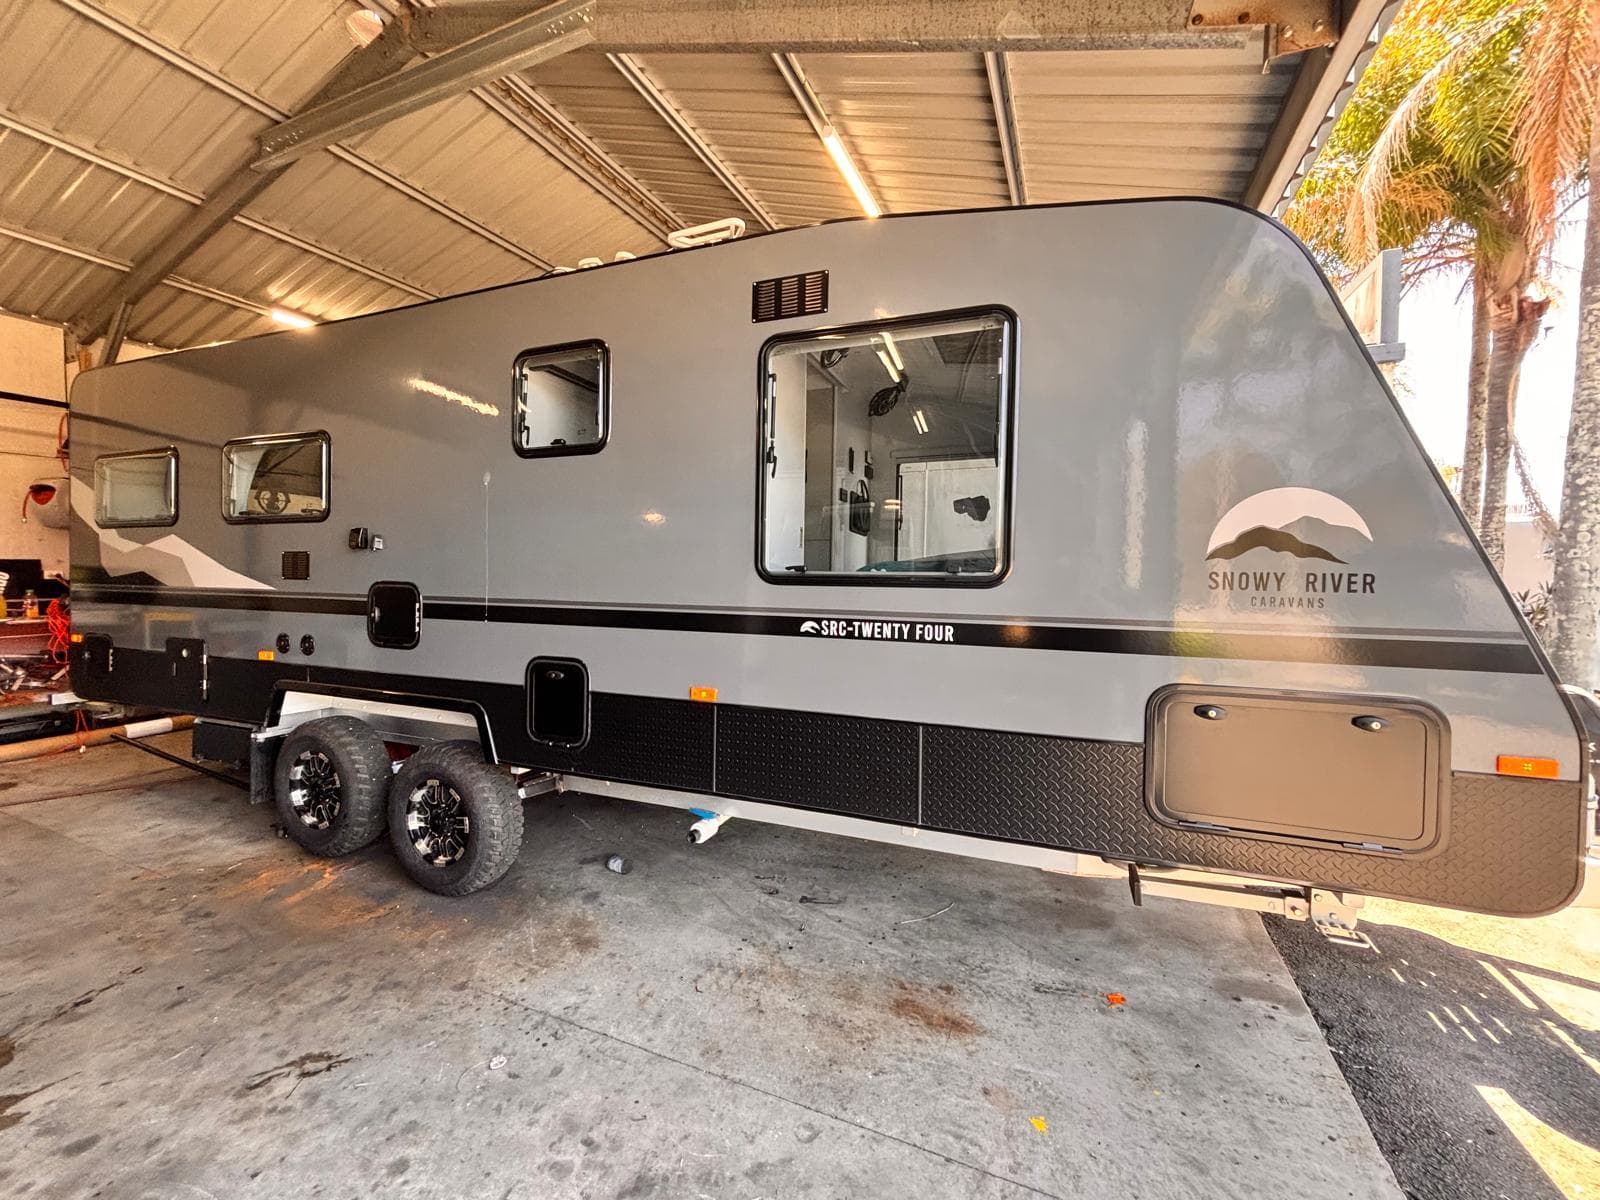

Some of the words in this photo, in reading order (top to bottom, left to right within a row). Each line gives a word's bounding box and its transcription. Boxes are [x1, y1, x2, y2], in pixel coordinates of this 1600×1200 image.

[1208, 571, 1286, 592] SNOWY
[1305, 572, 1376, 594] RIVER
[1250, 596, 1325, 609] CARAVANS
[820, 619, 911, 640] SRC-TWENTY
[915, 624, 954, 642] FOUR
